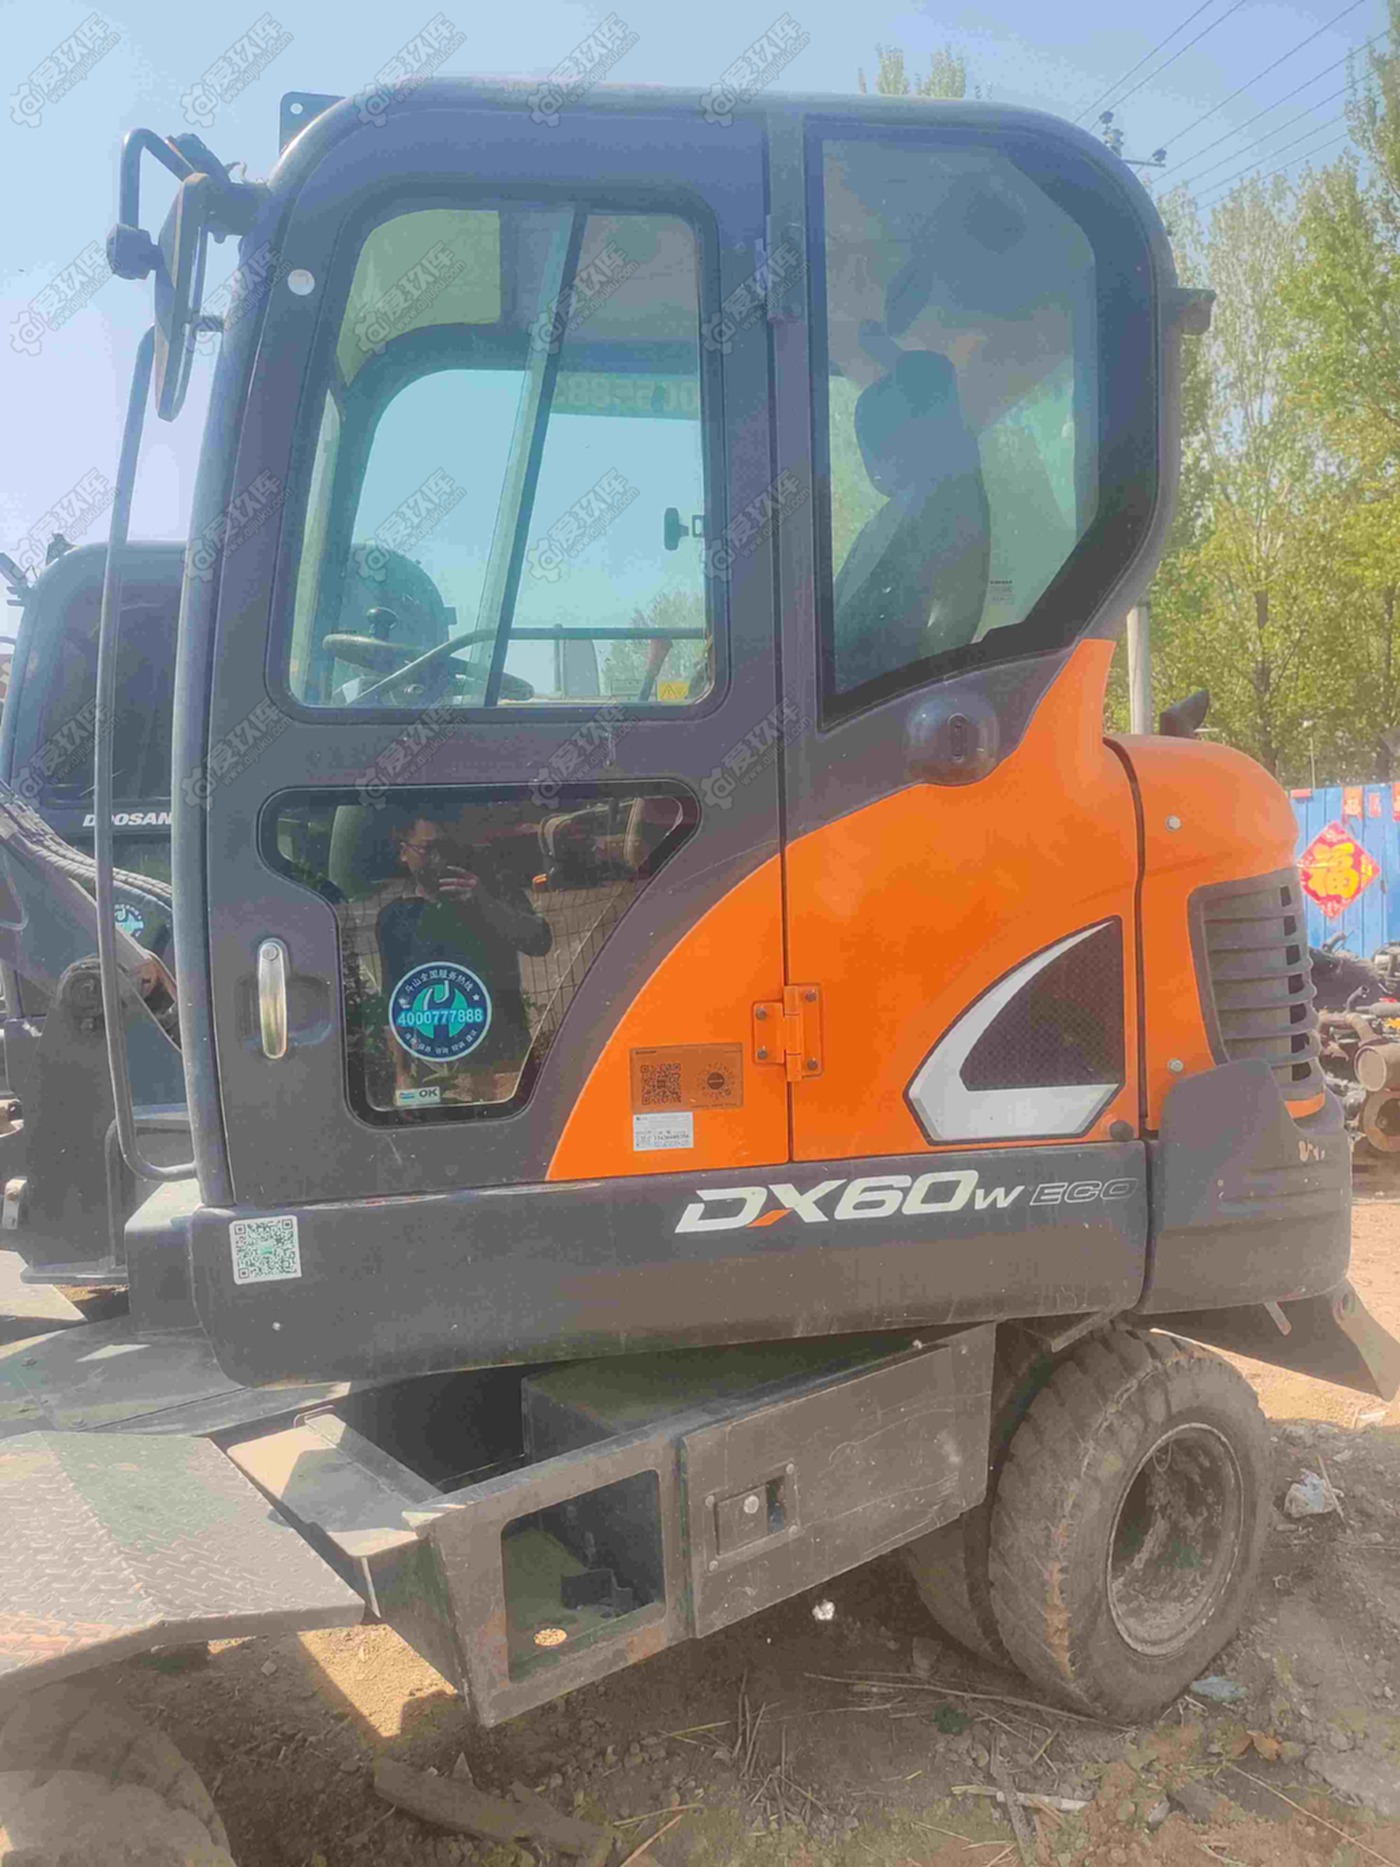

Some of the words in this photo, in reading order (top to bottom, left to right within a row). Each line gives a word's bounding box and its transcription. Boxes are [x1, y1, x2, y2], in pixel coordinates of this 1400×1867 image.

[82, 812, 172, 827] DOSAN
[1308, 842, 1359, 899] 福
[397, 1008, 483, 1027] 4000777888
[419, 1088, 438, 1098] OK
